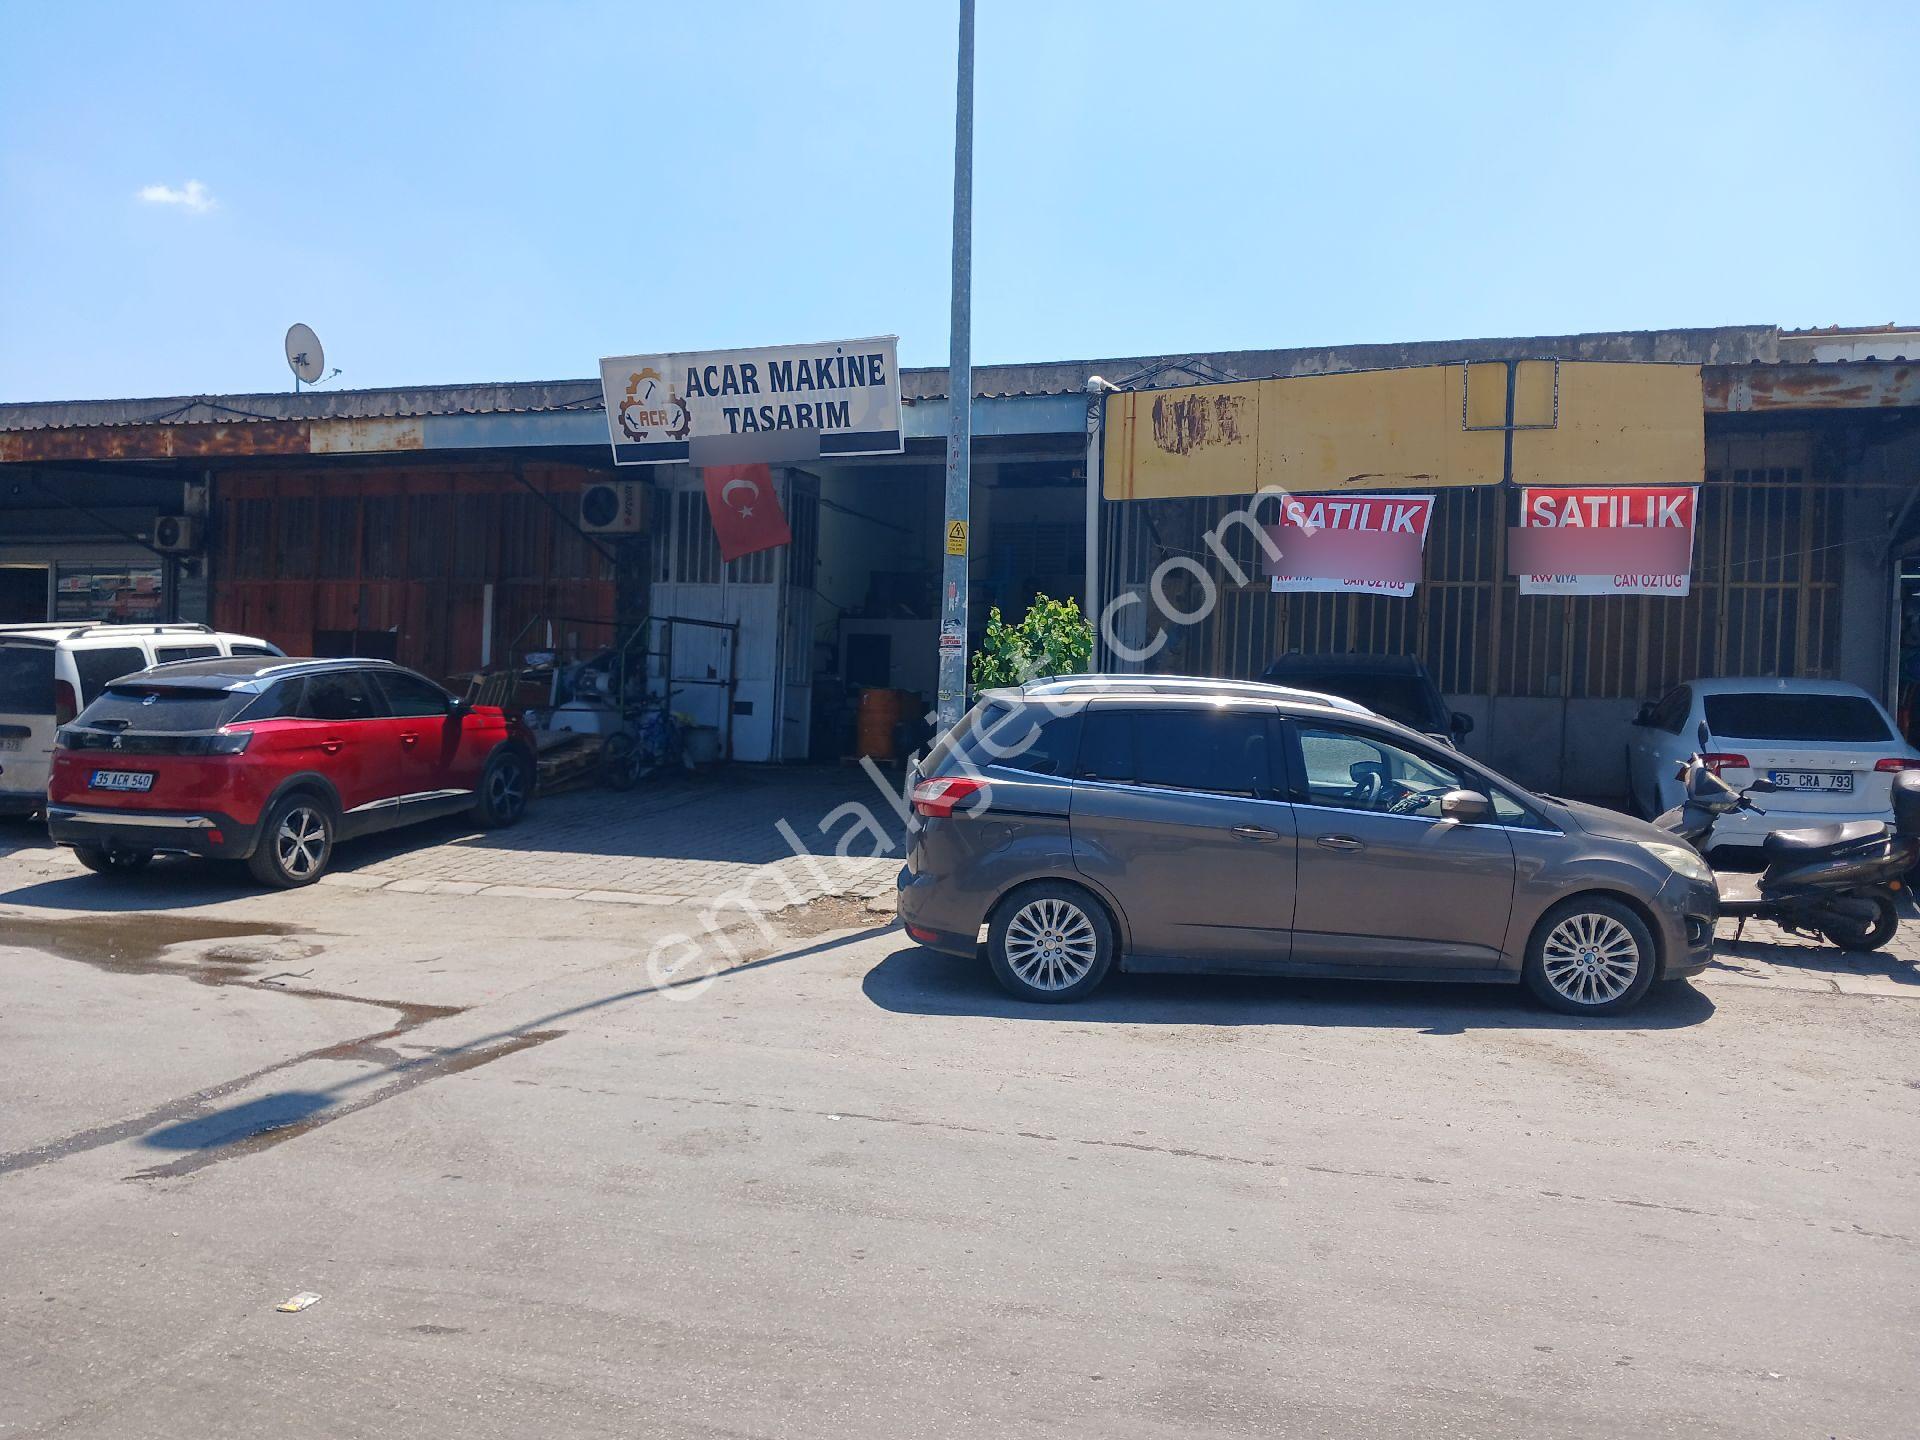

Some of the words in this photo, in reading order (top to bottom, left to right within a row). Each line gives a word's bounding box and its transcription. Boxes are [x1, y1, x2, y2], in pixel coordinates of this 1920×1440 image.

[686, 363, 760, 397] ACAR
[768, 346, 886, 393] MAKİNE
[639, 410, 669, 426] ACR
[722, 400, 851, 434] TASARIM
[1286, 501, 1423, 534] SATILIK
[1532, 495, 1687, 528] SATILIK
[1614, 574, 1638, 588] CAN
[96, 773, 109, 784] 35
[111, 774, 129, 786] ACR
[131, 775, 151, 787] 540
[1776, 774, 1790, 786] 35
[1799, 774, 1820, 787] CRA
[1829, 775, 1850, 788] 793
